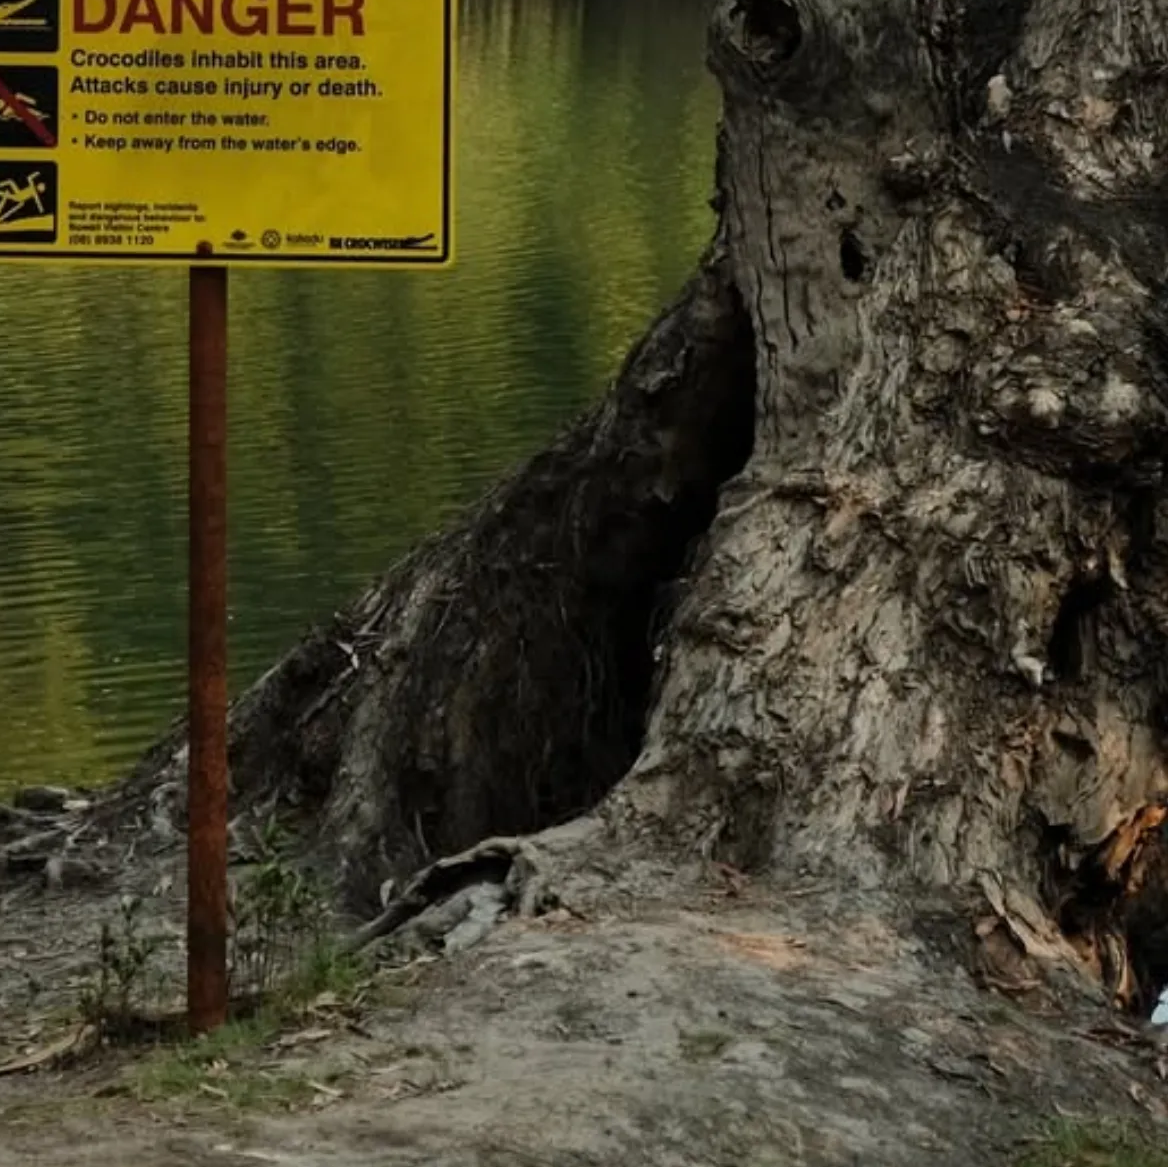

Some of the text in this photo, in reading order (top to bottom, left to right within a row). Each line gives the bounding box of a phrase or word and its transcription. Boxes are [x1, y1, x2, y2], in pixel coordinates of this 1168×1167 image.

[70, 48, 367, 70] Crocodiles inhabit this area.
[69, 76, 383, 100] Attacks cause injury or death.
[84, 109, 270, 127] Do not enter the water.
[84, 134, 363, 155] Keep away from the water's edge.
[126, 234, 155, 246] 1120
